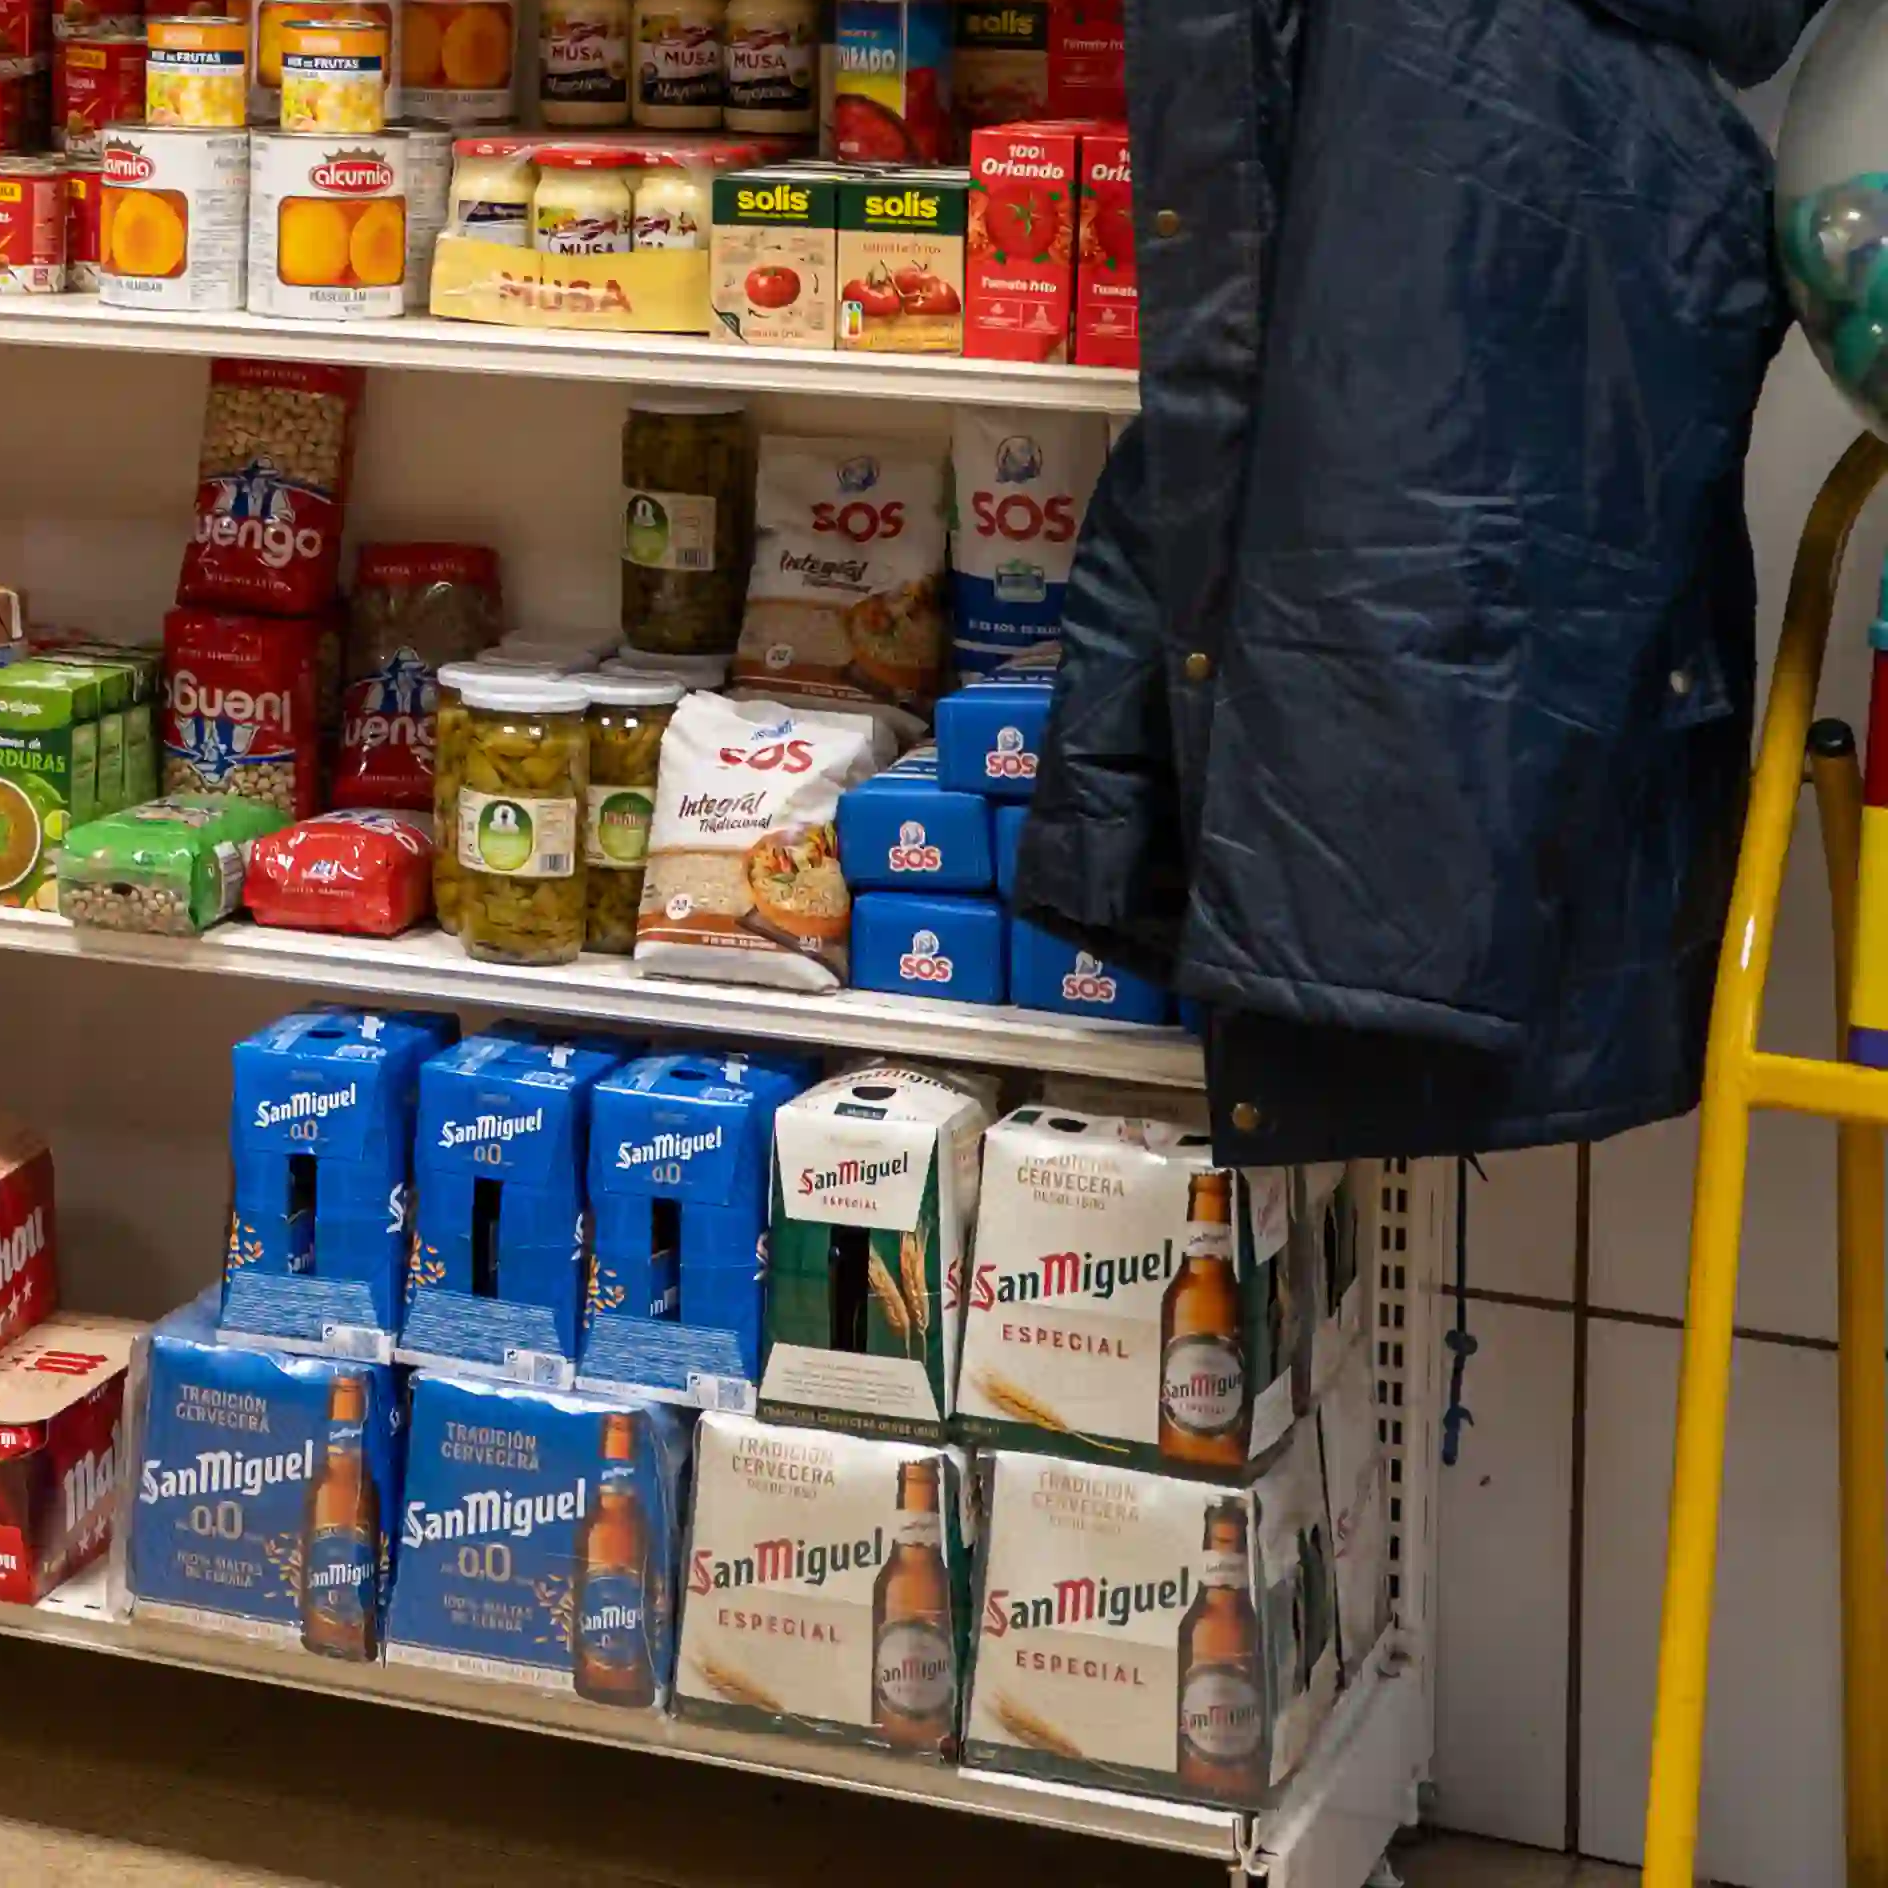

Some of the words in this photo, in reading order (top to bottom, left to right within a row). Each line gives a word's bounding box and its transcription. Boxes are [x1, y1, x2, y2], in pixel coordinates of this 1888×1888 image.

[313, 58, 359, 71] FRUTAS
[551, 44, 604, 62] MUSA
[733, 52, 787, 70] MUSA
[315, 165, 394, 188] alcurnia
[981, 157, 1065, 180] Orlando
[982, 277, 1024, 292] Tomate
[1026, 280, 1057, 294] frito
[972, 491, 1075, 541] SOS
[678, 794, 766, 819] Integral
[699, 814, 772, 832] Tradicional
[890, 846, 941, 870] SOS
[899, 956, 953, 980] SOS
[1062, 976, 1116, 1002] SOS
[253, 1081, 357, 1129] SanMiguel
[438, 1108, 544, 1149] SanMiguel
[616, 1126, 723, 1169] SanMiguel
[969, 1239, 1175, 1313] SanMiguel
[1002, 1324, 1130, 1360] ESPECIAL
[180, 1383, 268, 1414] TRADICIÓN
[174, 1401, 271, 1435] CERVECERA
[440, 1439, 540, 1471] CERVECERA
[139, 1439, 314, 1505] SanMiguel
[402, 1477, 586, 1548] SanMiguel
[688, 1526, 885, 1596] SanMiguel
[982, 1567, 1191, 1637] SanMiguel
[716, 1608, 842, 1644] ESPECIAL
[1014, 1648, 1145, 1686] ESPECIAL
